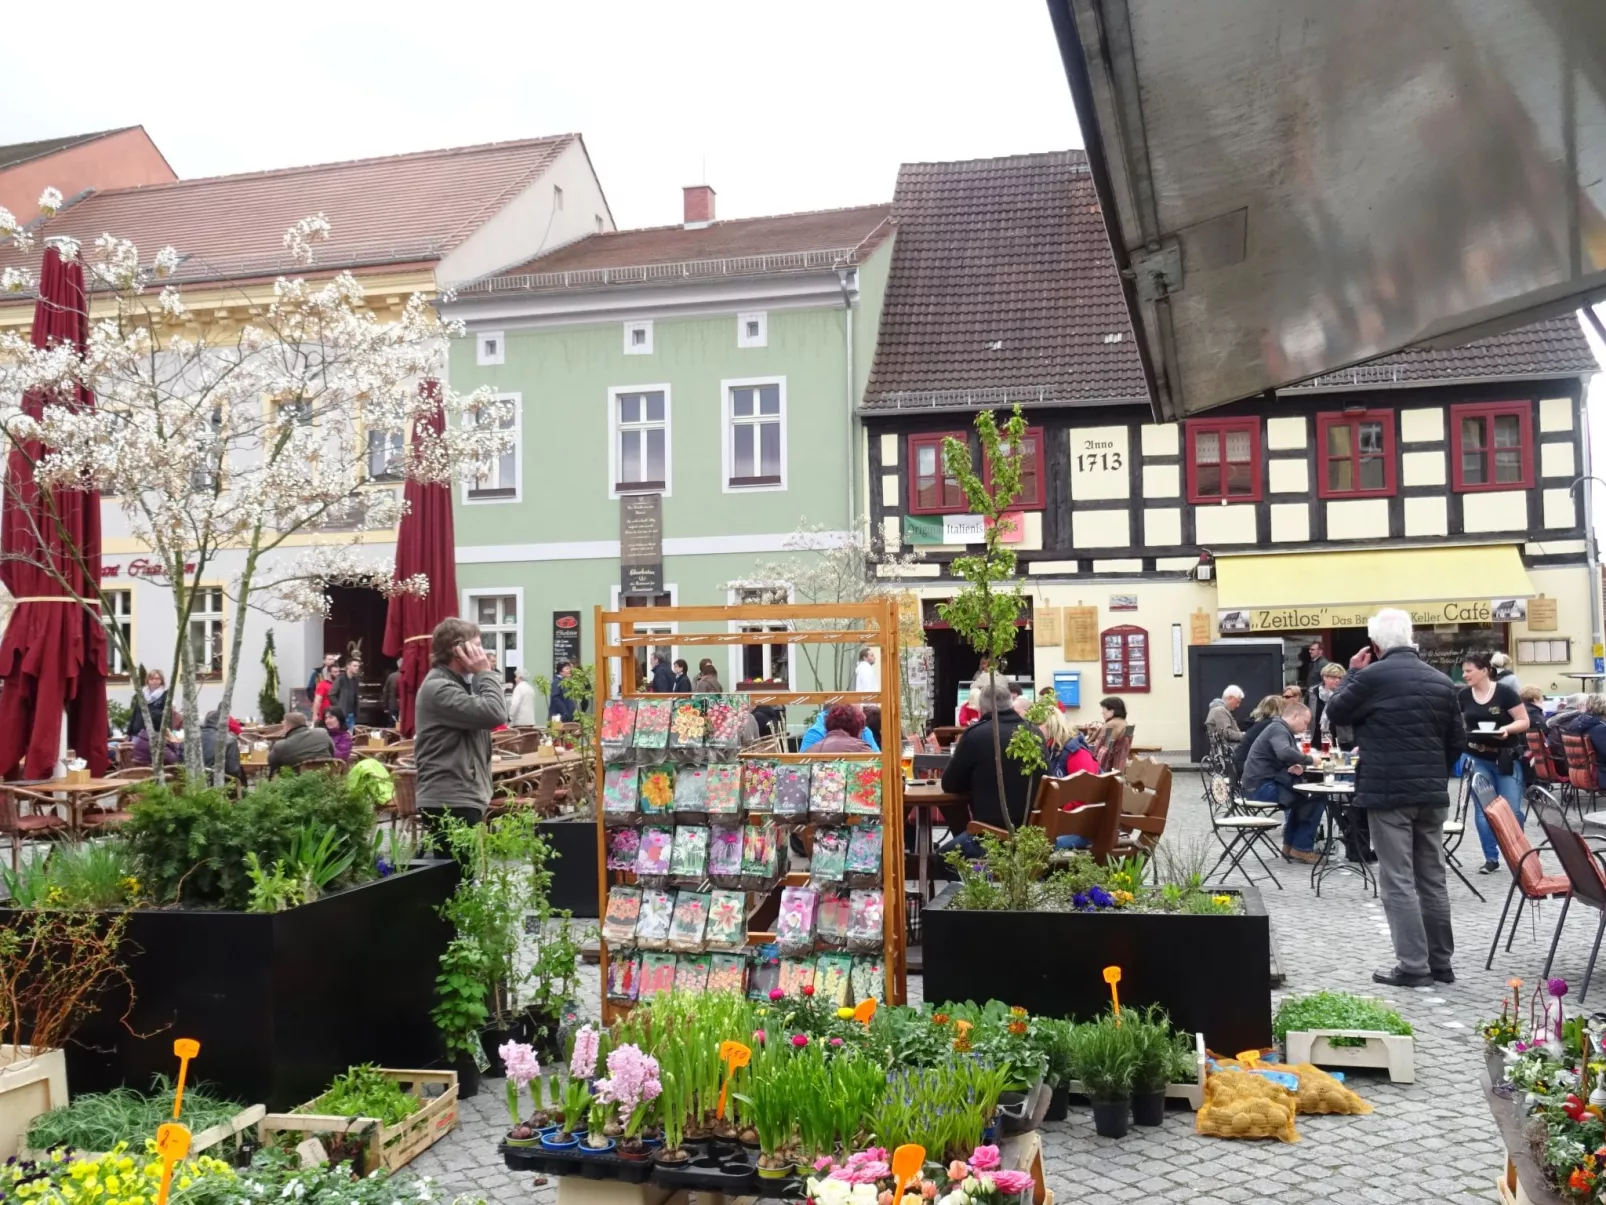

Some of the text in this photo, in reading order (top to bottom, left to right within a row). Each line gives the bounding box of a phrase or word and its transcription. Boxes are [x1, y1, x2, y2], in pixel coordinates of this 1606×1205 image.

[1084, 440, 1114, 450] Anno
[1076, 452, 1123, 473] 1713
[1331, 614, 1353, 626] Das
[1443, 602, 1490, 621] Café
